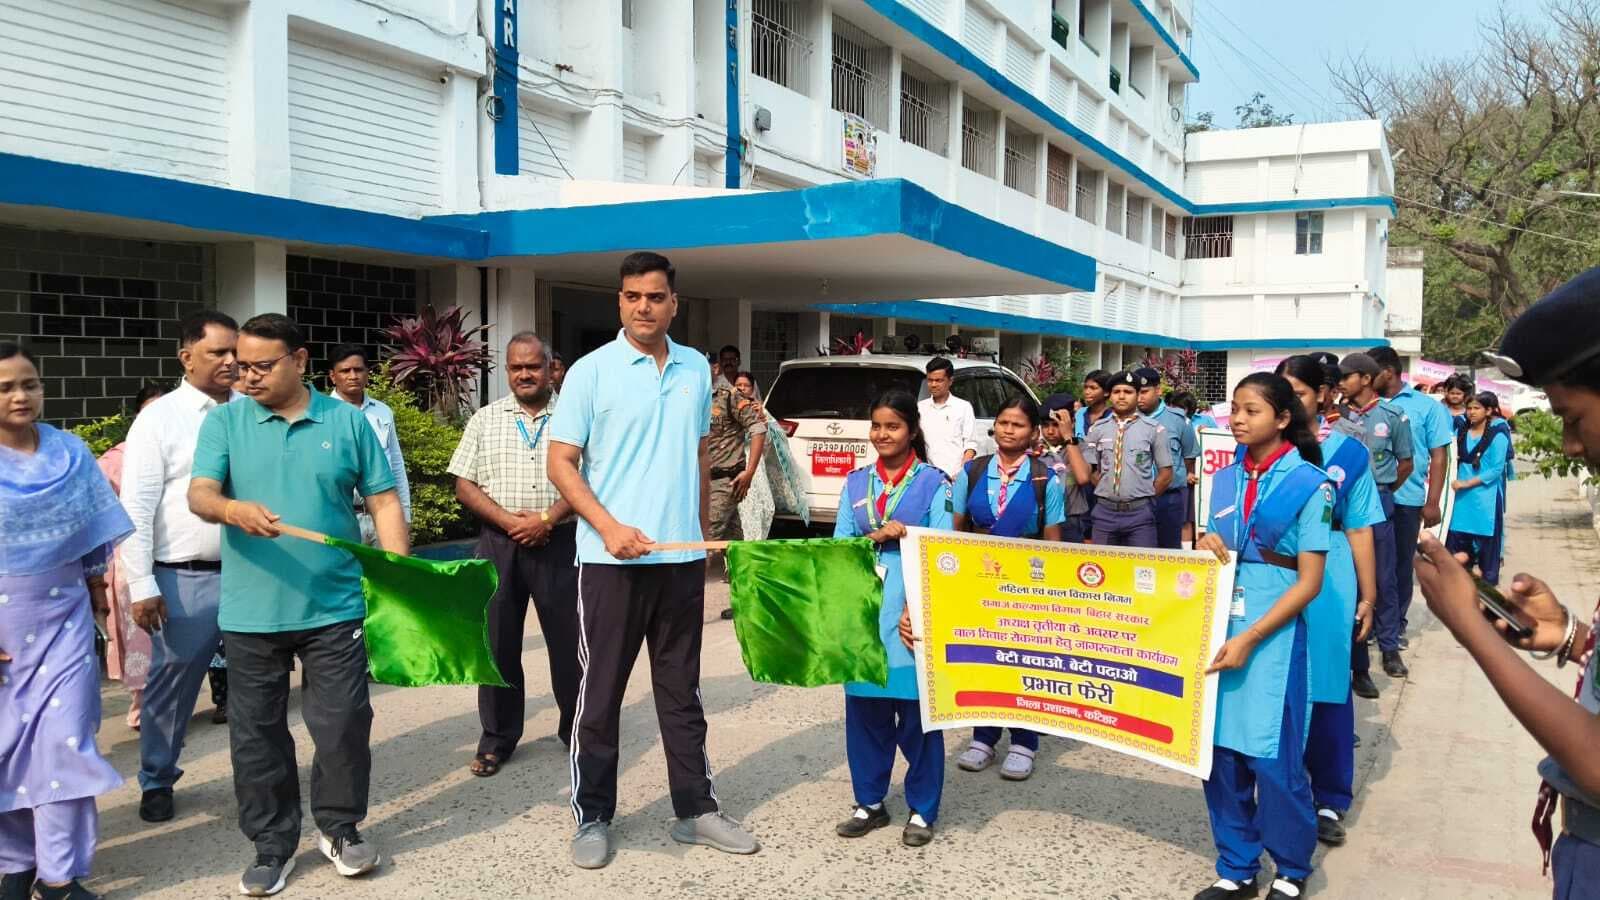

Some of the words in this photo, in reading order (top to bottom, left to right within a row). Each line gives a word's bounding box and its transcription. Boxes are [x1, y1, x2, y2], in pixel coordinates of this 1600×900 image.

[998, 583, 1029, 594] महिला
[1047, 588, 1067, 598] बाल
[1069, 589, 1101, 601] विकास
[1104, 592, 1132, 605] निगम
[982, 599, 1010, 609] समाज
[1012, 602, 1049, 612] कल्याण
[1086, 607, 1111, 618] बिहार
[1115, 614, 1150, 625] सरकार
[1032, 619, 1066, 633] तृतीया
[1068, 622, 1080, 634] के
[1085, 627, 1119, 640] अवसर
[1121, 632, 1137, 642] पर
[954, 628, 976, 638] बाल
[978, 627, 1008, 641] विवाह
[1011, 630, 1052, 646] रोकथाम
[1055, 635, 1072, 651] हेतु
[1075, 640, 1133, 657] जागरूकता
[1136, 649, 1179, 667] कार्यक्रम
[995, 649, 1018, 664] बेटी
[1069, 658, 1093, 674] बेटी
[1022, 675, 1072, 696] प्रभात
[1078, 680, 1114, 705] फेरी
[1015, 696, 1041, 710] जिला
[1083, 708, 1118, 727] कटिहार
